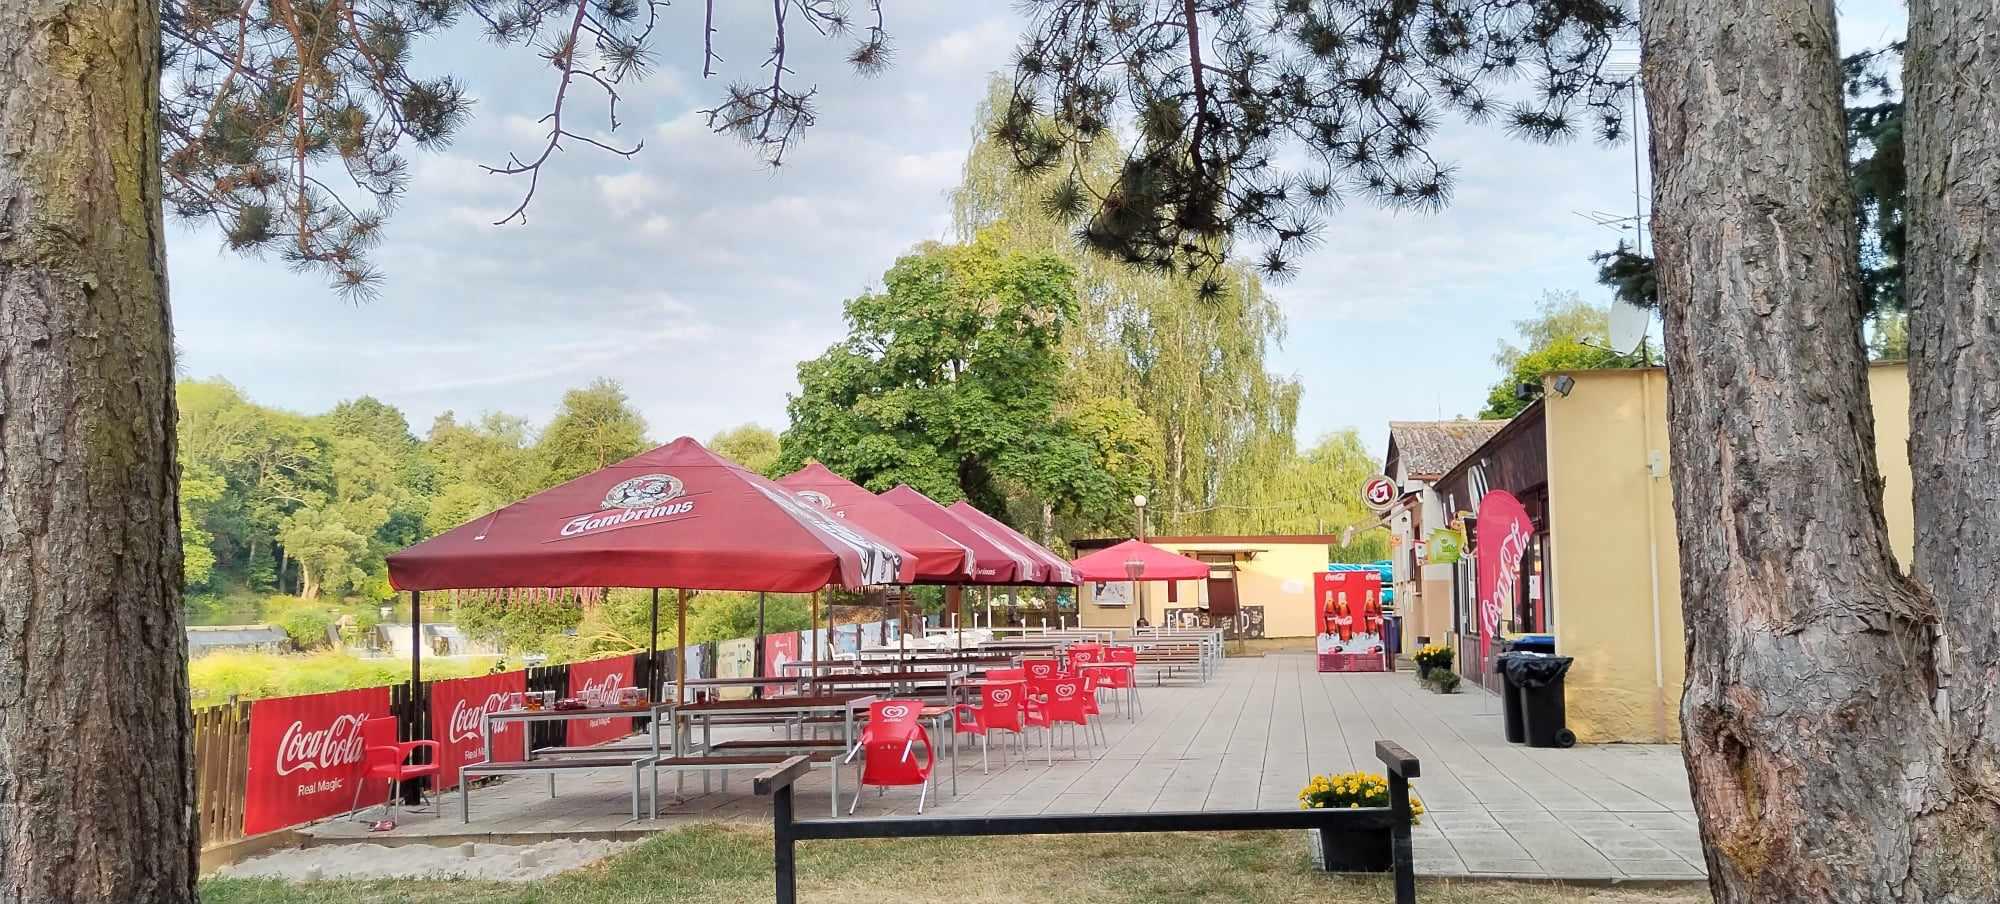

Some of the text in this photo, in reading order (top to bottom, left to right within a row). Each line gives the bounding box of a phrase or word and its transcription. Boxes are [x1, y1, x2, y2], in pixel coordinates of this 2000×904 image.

[560, 500, 695, 537] Gambrinus
[276, 712, 370, 776] Coca-Cola
[298, 776, 345, 797] Real Magic
